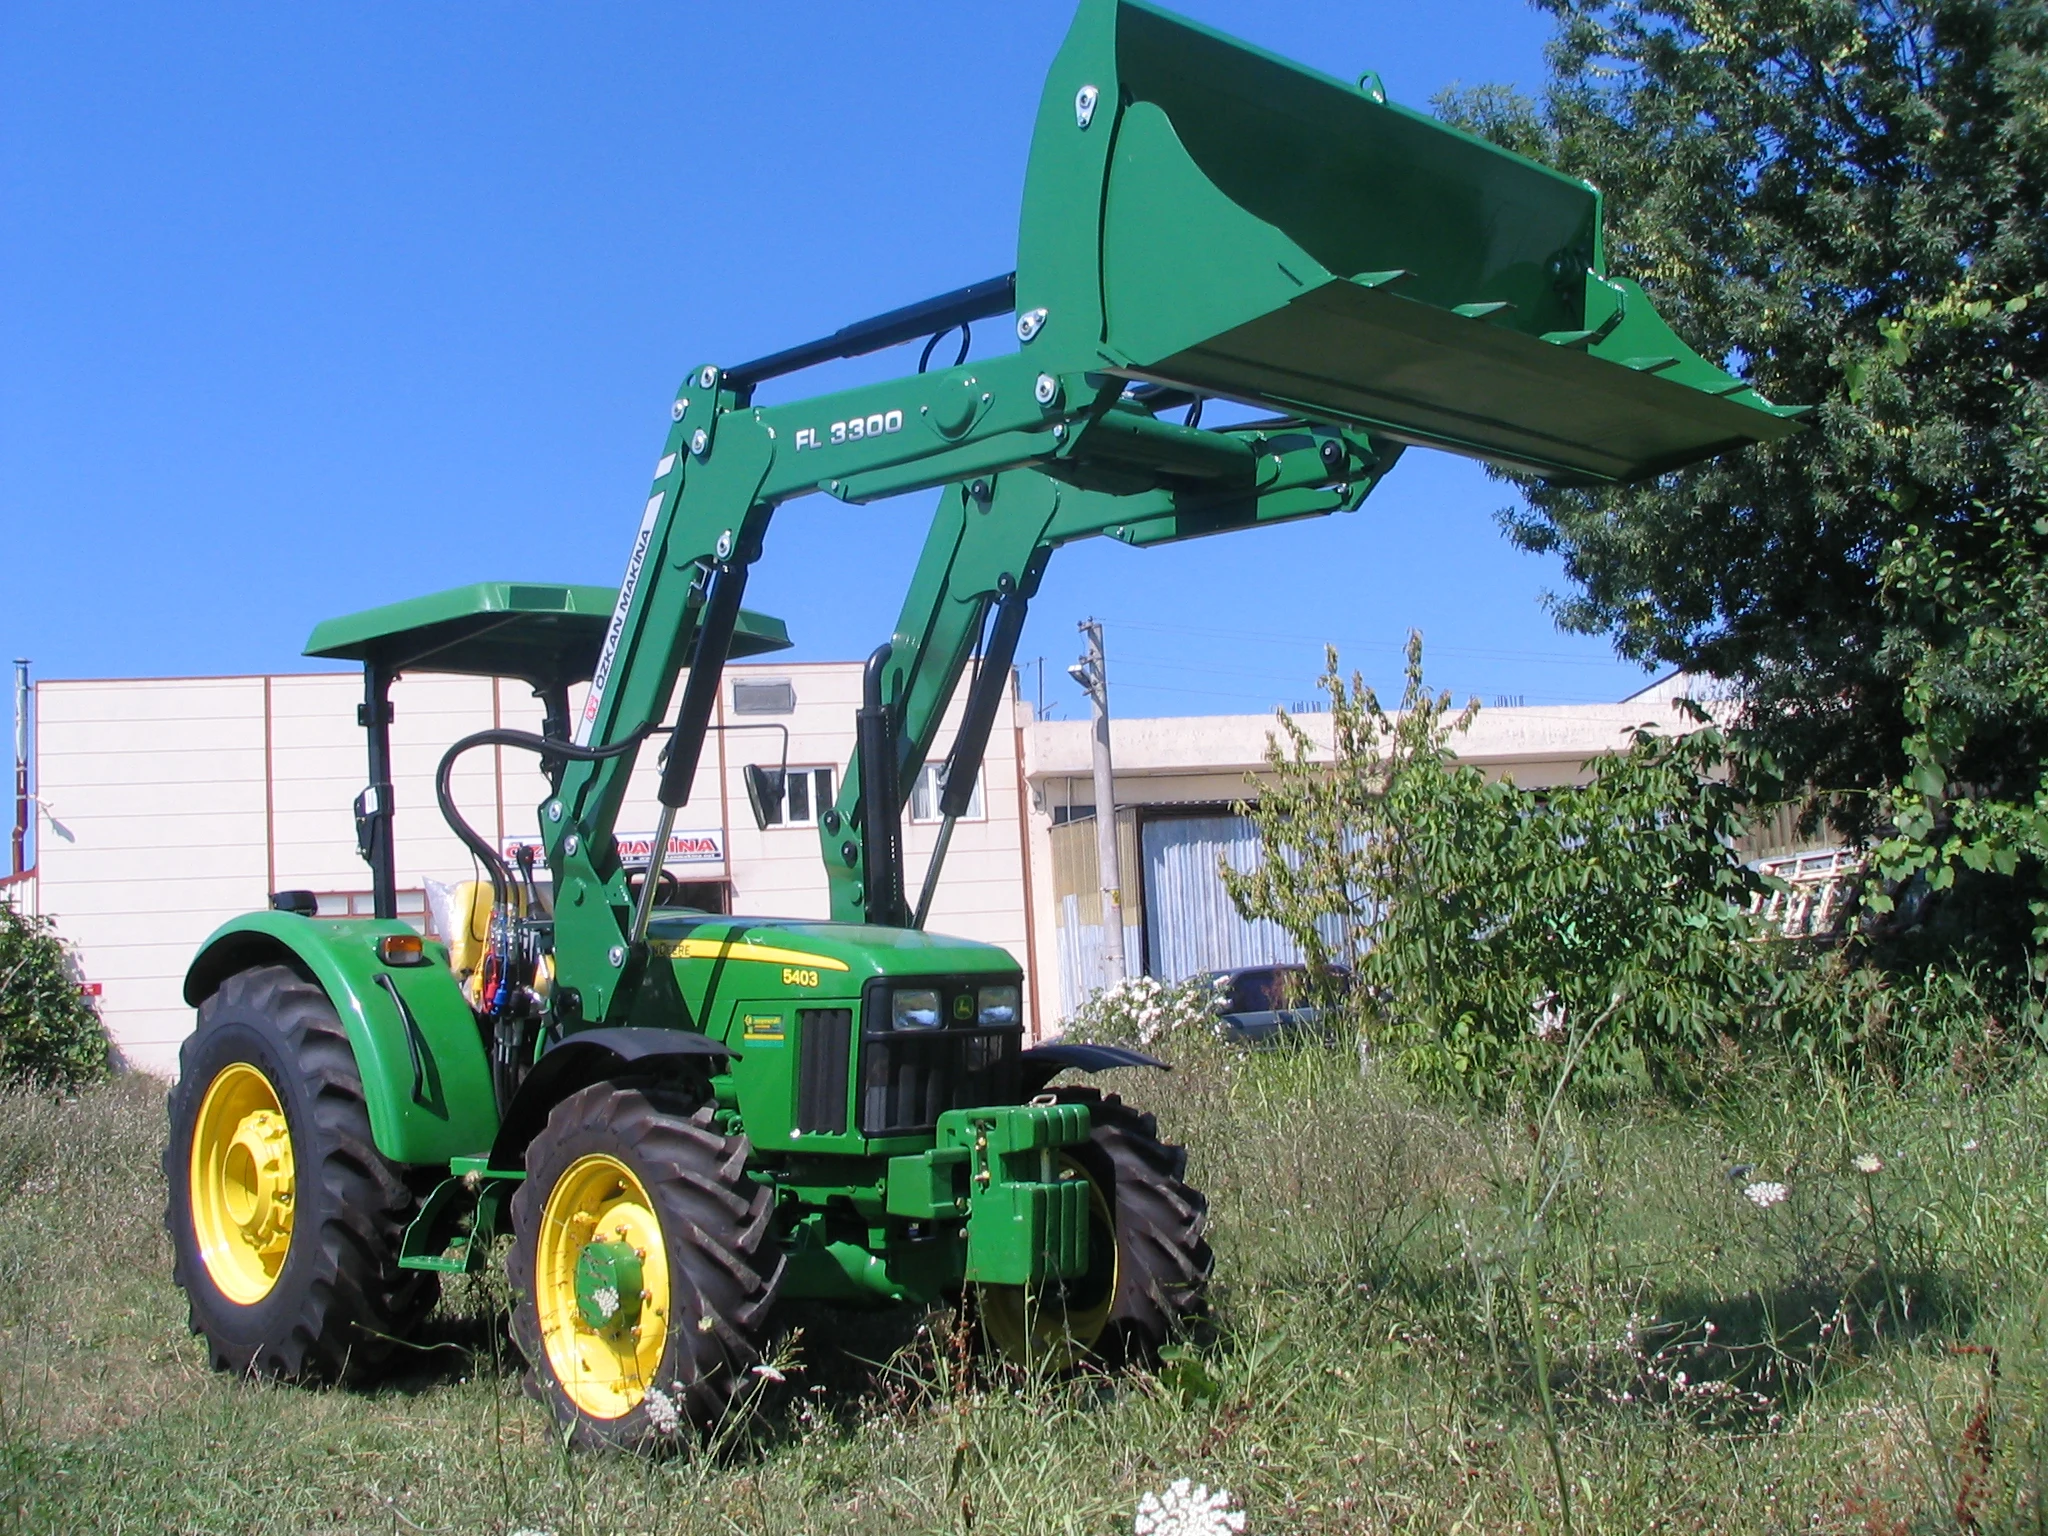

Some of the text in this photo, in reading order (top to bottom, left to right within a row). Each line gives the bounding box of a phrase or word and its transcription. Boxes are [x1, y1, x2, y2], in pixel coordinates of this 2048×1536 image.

[795, 410, 903, 451] FL 3300
[617, 836, 718, 855] MAİNA
[782, 968, 819, 987] 5403
